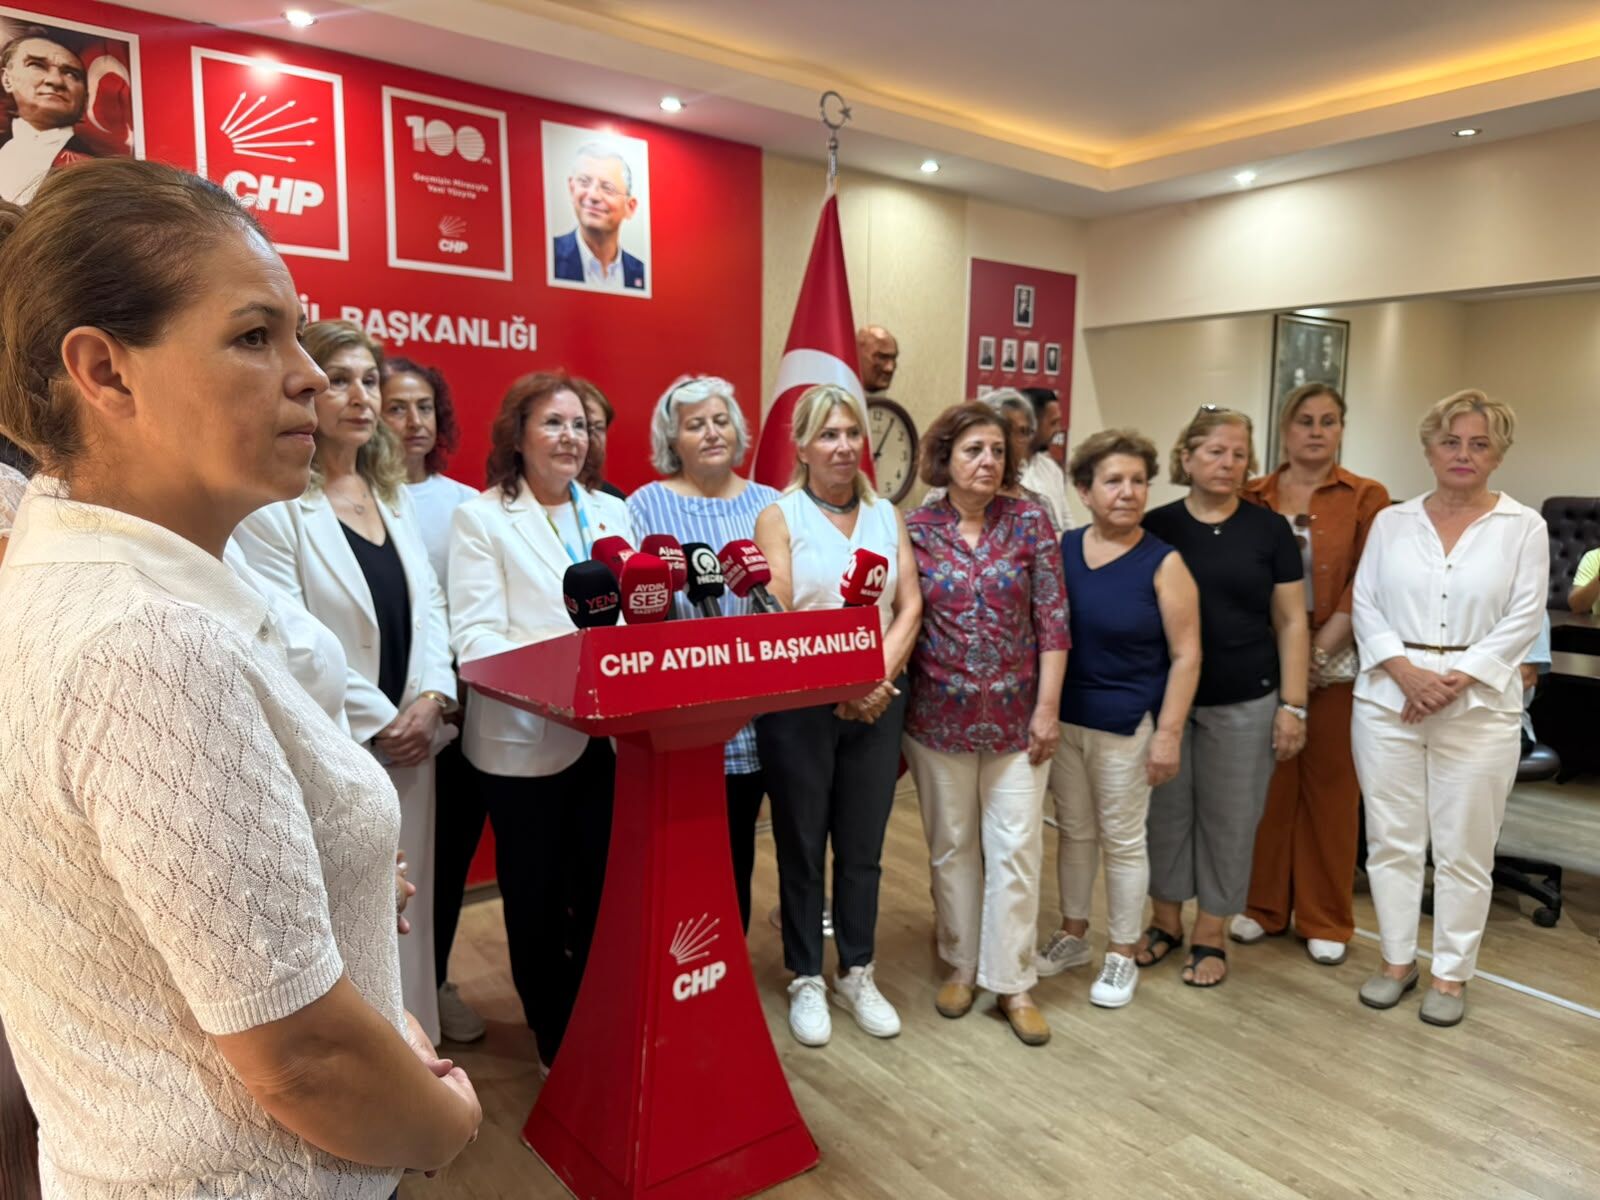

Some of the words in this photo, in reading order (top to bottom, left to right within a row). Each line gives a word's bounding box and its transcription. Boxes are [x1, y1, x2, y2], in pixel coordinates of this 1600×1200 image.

[405, 115, 485, 162] 100
[222, 170, 324, 216] CHP
[438, 239, 469, 254] CHP
[340, 305, 538, 351] BAŞKANLIĞI
[633, 592, 666, 607] SES
[634, 582, 665, 592] AYDIN
[599, 651, 654, 677] CHP
[660, 644, 731, 671] AYDIN
[735, 637, 755, 663] İL
[759, 626, 877, 664] BAŞKANLIĞI
[672, 960, 727, 1001] CHP
